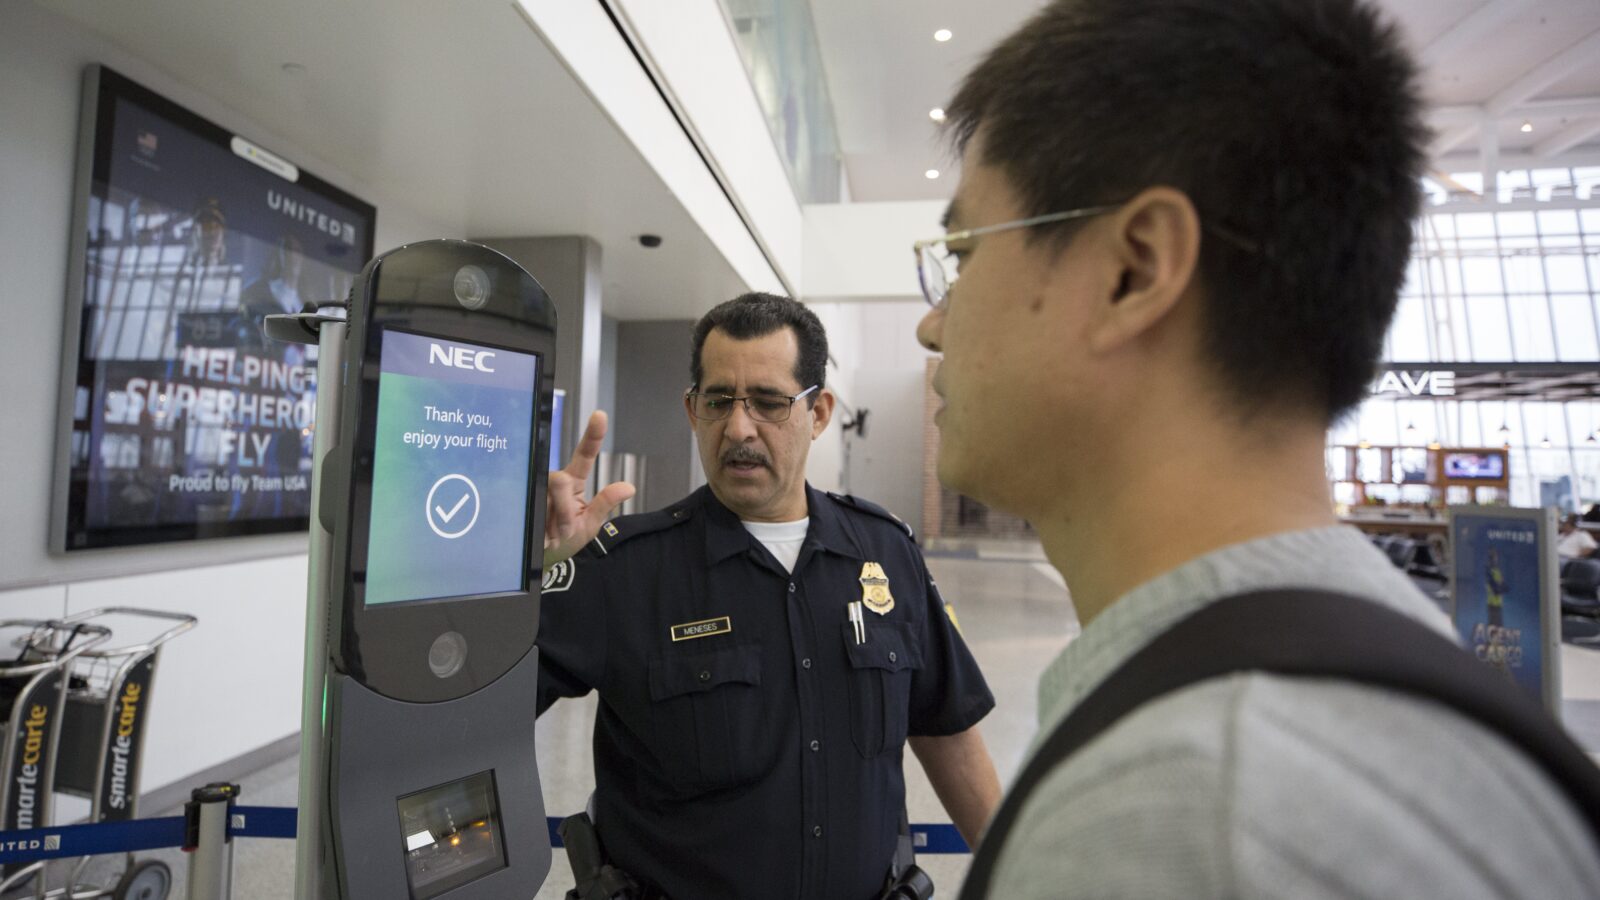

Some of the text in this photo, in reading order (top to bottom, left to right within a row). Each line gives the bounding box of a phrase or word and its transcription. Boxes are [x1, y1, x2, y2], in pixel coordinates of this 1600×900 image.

[267, 189, 339, 236] UNITED
[183, 346, 306, 395] HELPING
[429, 343, 496, 373] NEC
[424, 406, 493, 428] Thank you,
[217, 431, 271, 468] FLY
[403, 430, 508, 453] enjoy your flight
[169, 473, 307, 494] Proud to fly Team USA
[683, 622, 718, 636] MENESES
[17, 704, 48, 829] martecarte
